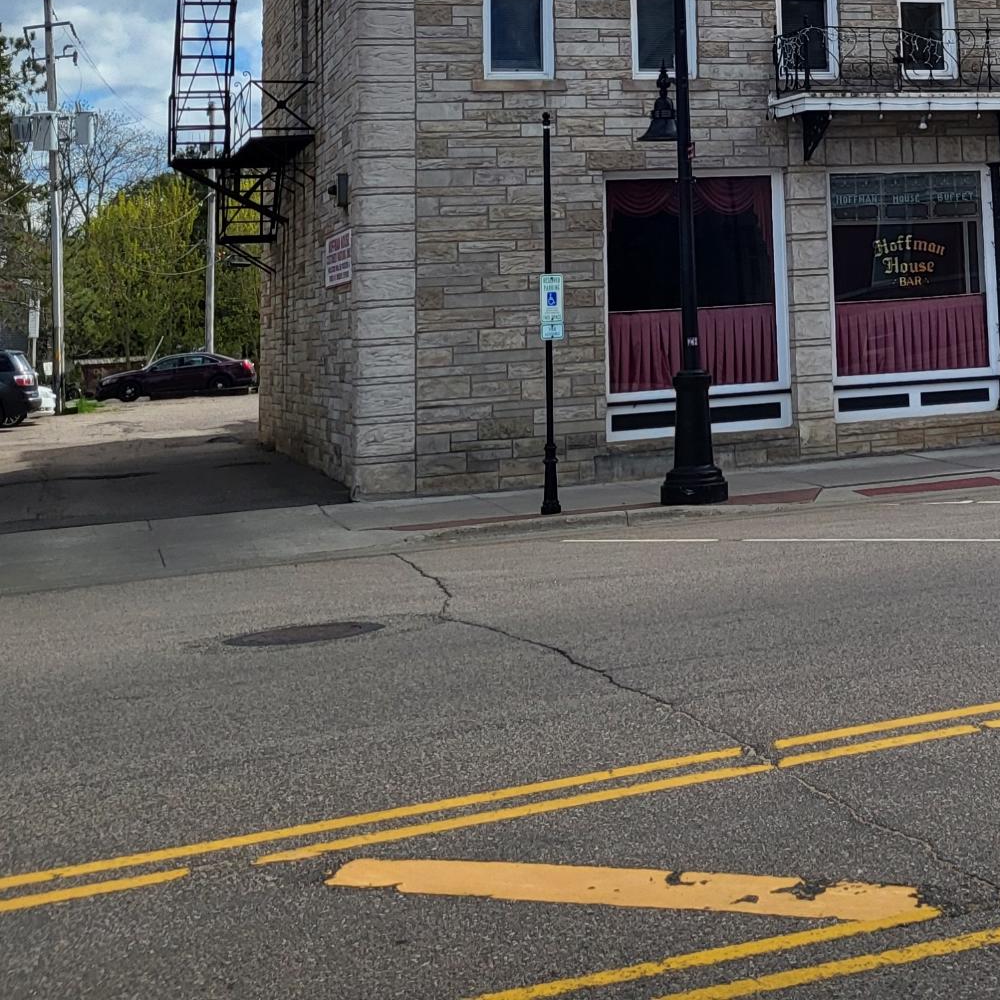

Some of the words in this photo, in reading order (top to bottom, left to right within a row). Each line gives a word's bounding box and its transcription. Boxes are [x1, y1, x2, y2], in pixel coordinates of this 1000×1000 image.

[835, 193, 878, 206] HOFFMAN
[892, 193, 920, 204] HOUSE
[937, 191, 974, 202] BUFFET
[873, 234, 946, 258] Hoffman
[882, 256, 935, 274] House
[899, 276, 922, 287] BAR
